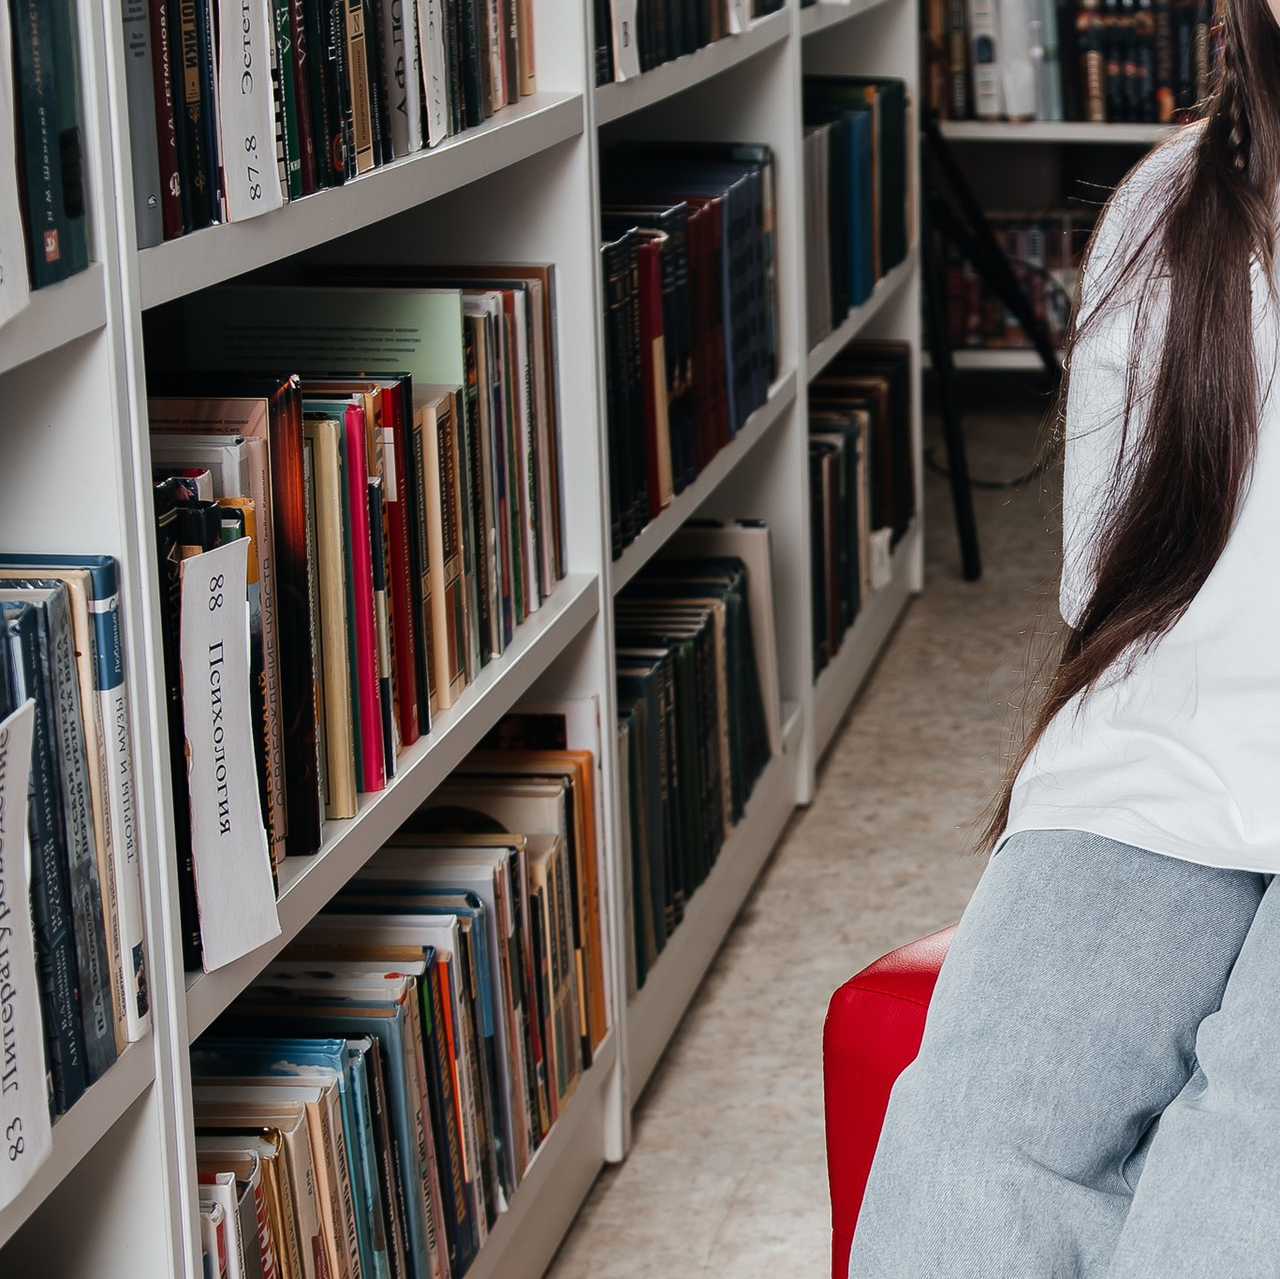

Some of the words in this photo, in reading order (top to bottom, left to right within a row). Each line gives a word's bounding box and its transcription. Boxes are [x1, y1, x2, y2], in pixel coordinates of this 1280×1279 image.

[159, 4, 174, 107] ГЕТМАНОВА
[244, 135, 262, 203] 87.8
[208, 573, 225, 612] 88
[262, 557, 275, 634] ЧУВСТВ
[61, 633, 72, 684] ВЕКА
[56, 639, 72, 762] ЛИТЕРАТУРА
[114, 696, 128, 753] МУЗЫ
[267, 638, 284, 806] ОСВОБОЖДЕНИЕ
[69, 725, 81, 766] ТРЕТИ
[119, 759, 129, 773] И
[208, 638, 231, 836] Психология
[67, 774, 82, 861] РУССКАЯ
[75, 782, 90, 854] ПЕРВОЙ
[122, 781, 136, 863] ТВОРЦЫ
[431, 968, 451, 1099] ОБЩЕНИЕ
[5, 1116, 25, 1161] 83
[335, 1132, 347, 1182] ПАМЯТЬ
[445, 1103, 466, 1225] ДЕЛОВОЕ
[304, 1169, 313, 1196] ДЛЯ
[341, 1184, 356, 1244] УЛУЧШИТЬ
